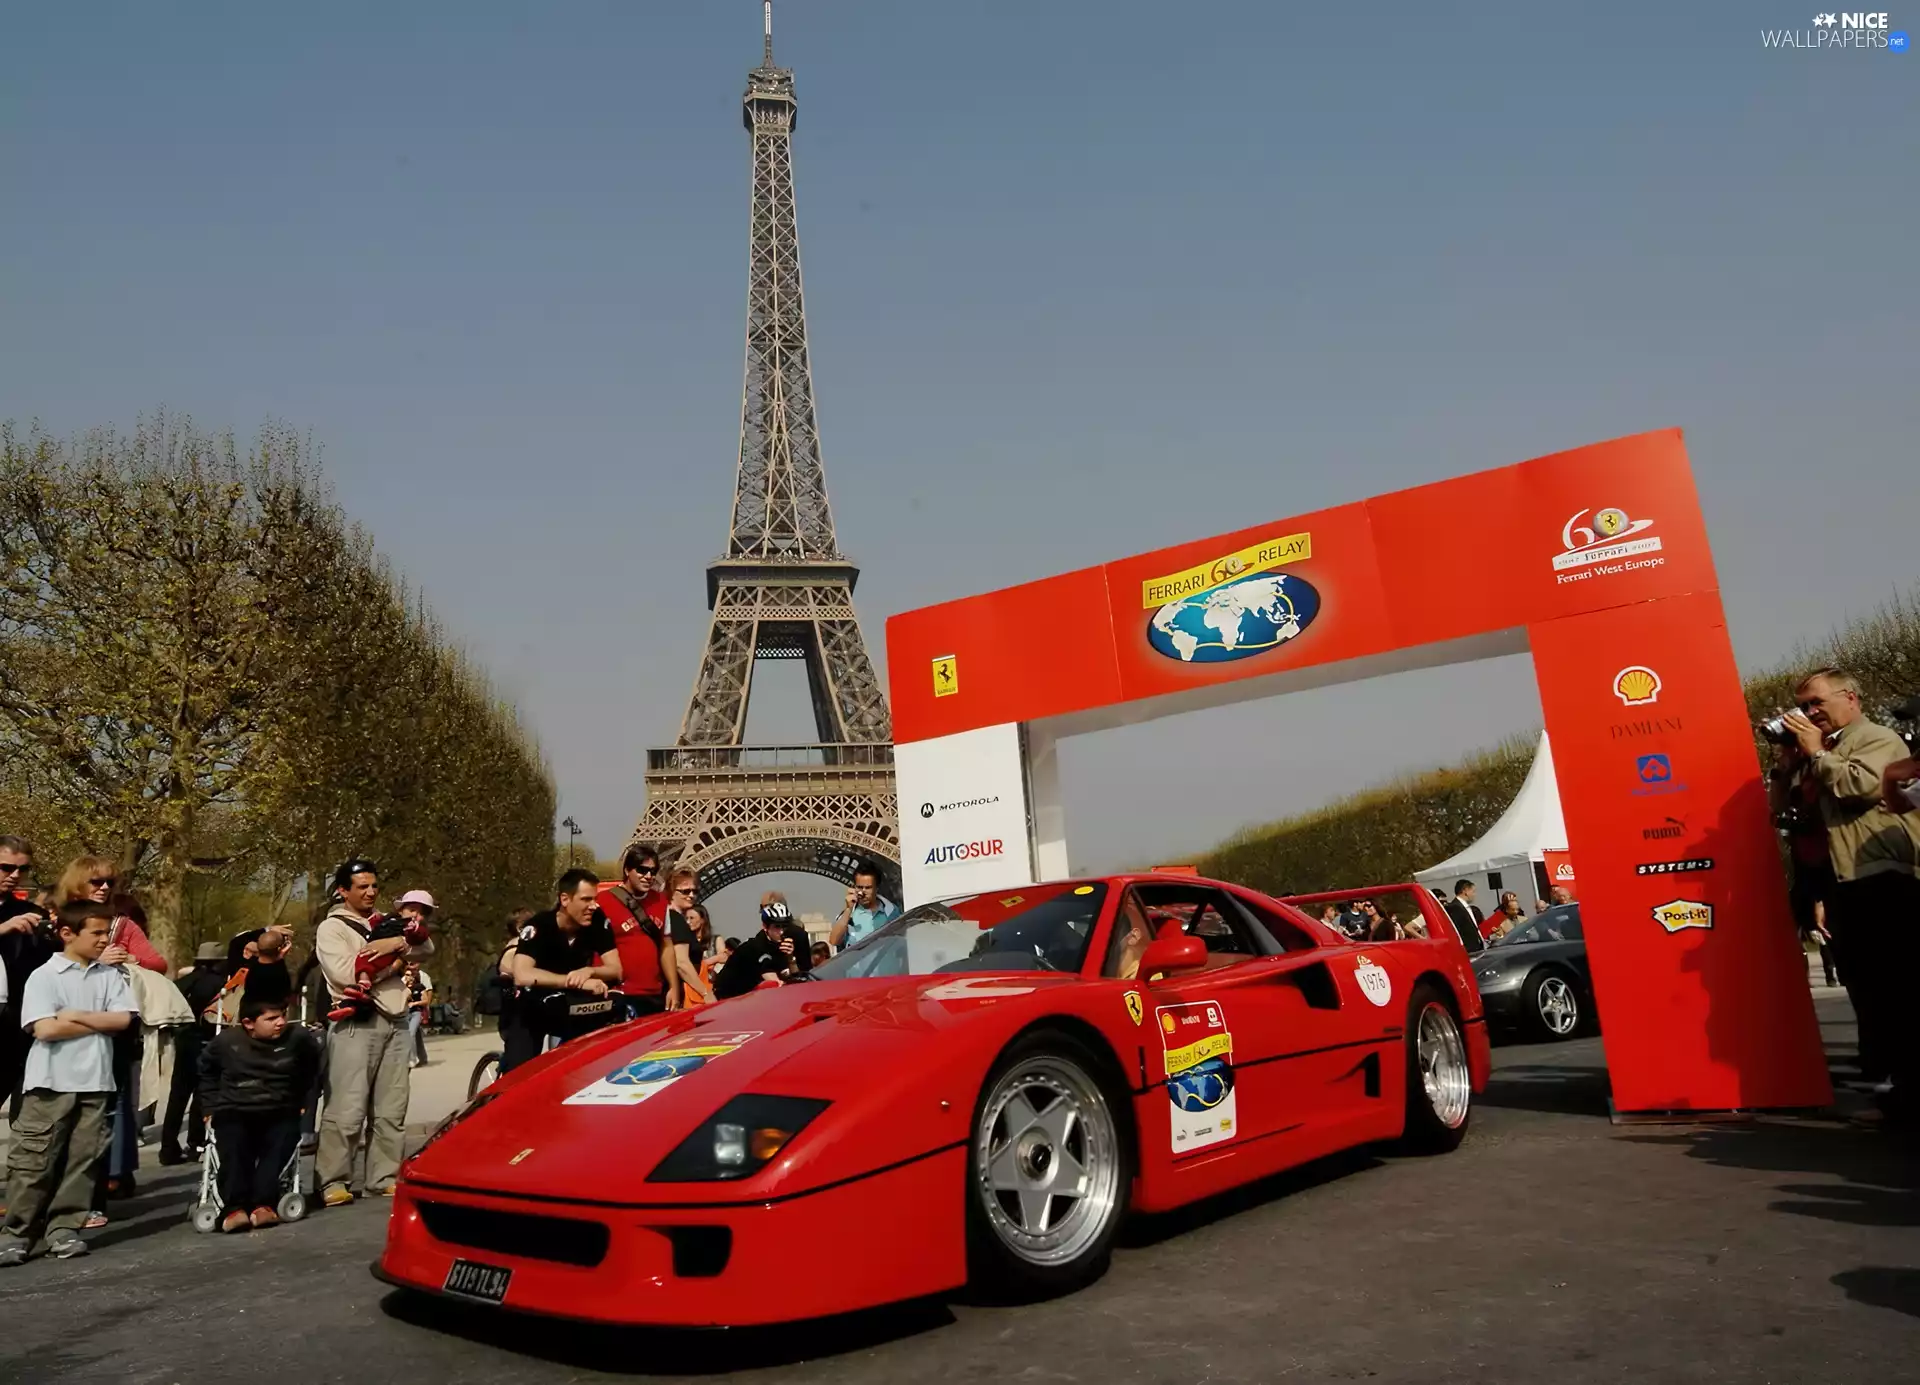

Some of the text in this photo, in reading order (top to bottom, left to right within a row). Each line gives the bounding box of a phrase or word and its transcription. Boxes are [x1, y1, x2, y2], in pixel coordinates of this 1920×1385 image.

[1149, 573, 1205, 600] FERRARI
[1258, 539, 1305, 563] RELAY
[1556, 557, 1665, 584] Ferrari West Europe
[939, 796, 999, 811] MOTOROLA
[924, 838, 1004, 865] AUTOSUR
[1363, 973, 1386, 991] 1976
[576, 1003, 605, 1013] POLICE
